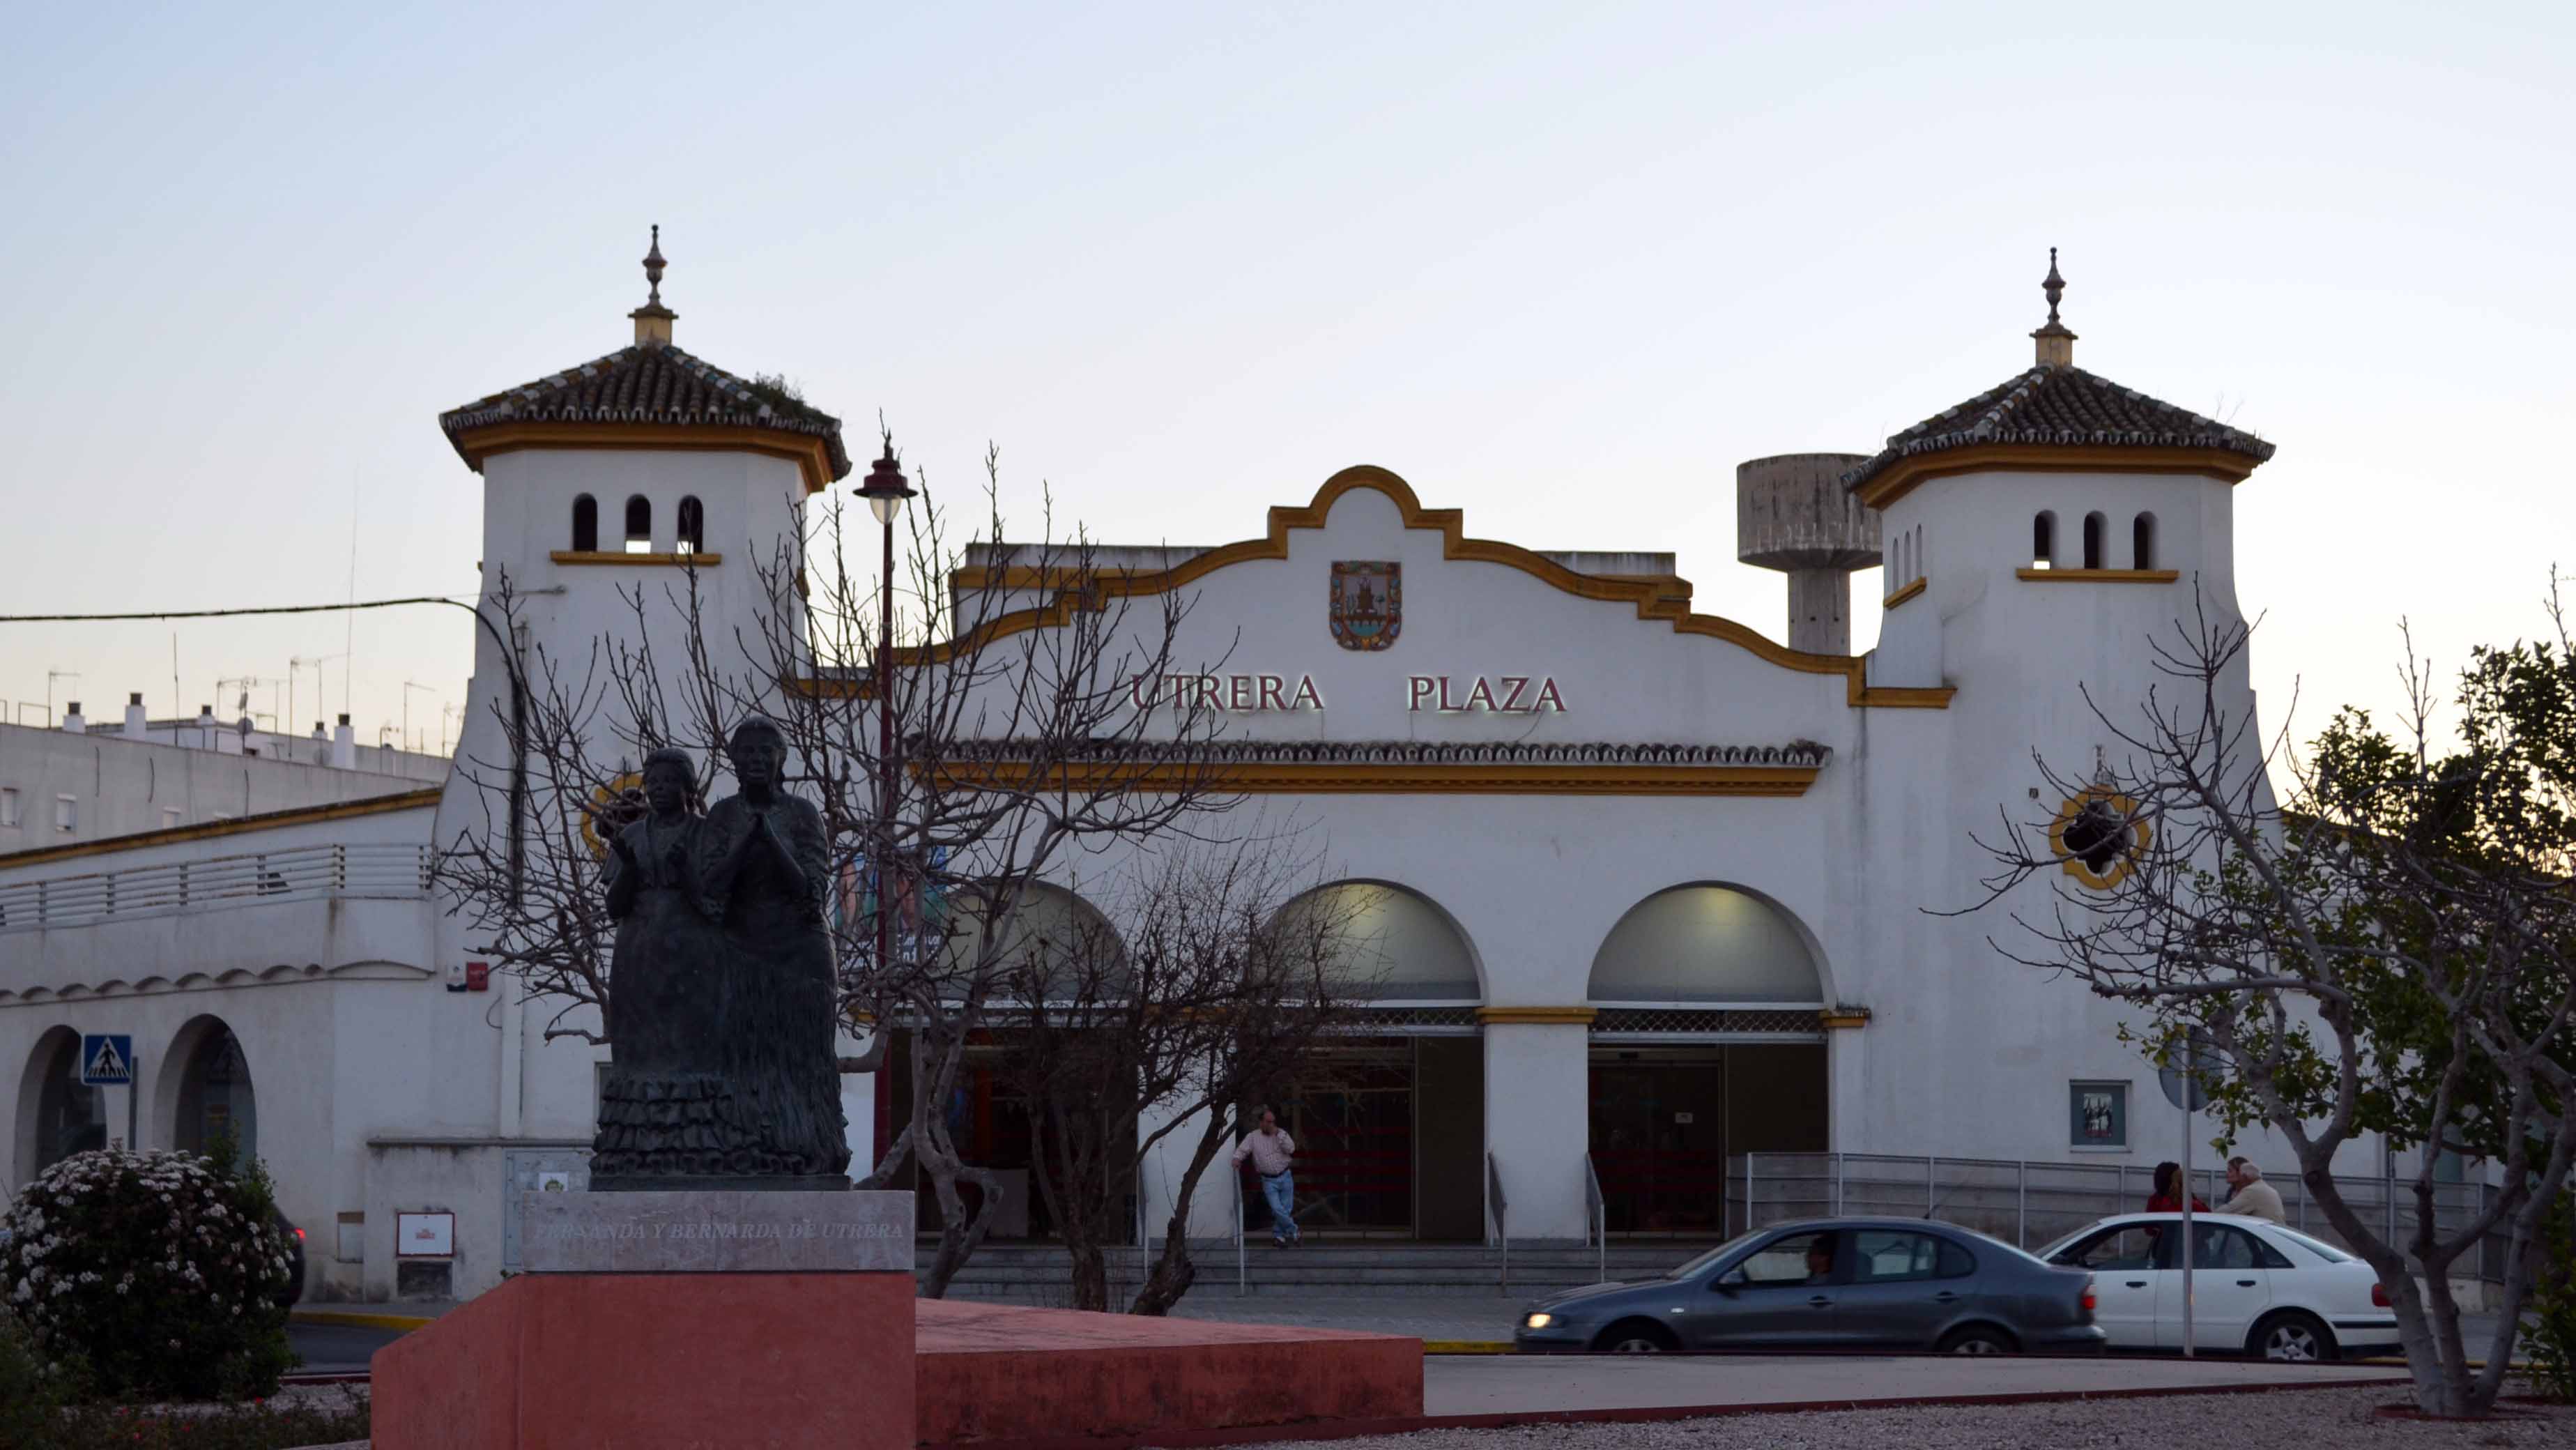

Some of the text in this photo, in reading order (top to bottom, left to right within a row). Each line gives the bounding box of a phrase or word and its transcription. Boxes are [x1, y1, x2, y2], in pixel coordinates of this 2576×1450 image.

[1130, 675, 1566, 712] UTRERA PLAZA
[653, 1223, 665, 1239] Y
[670, 1223, 781, 1239] BERNARDA
[788, 1223, 816, 1238] DE
[823, 1223, 904, 1238] UTRERA
